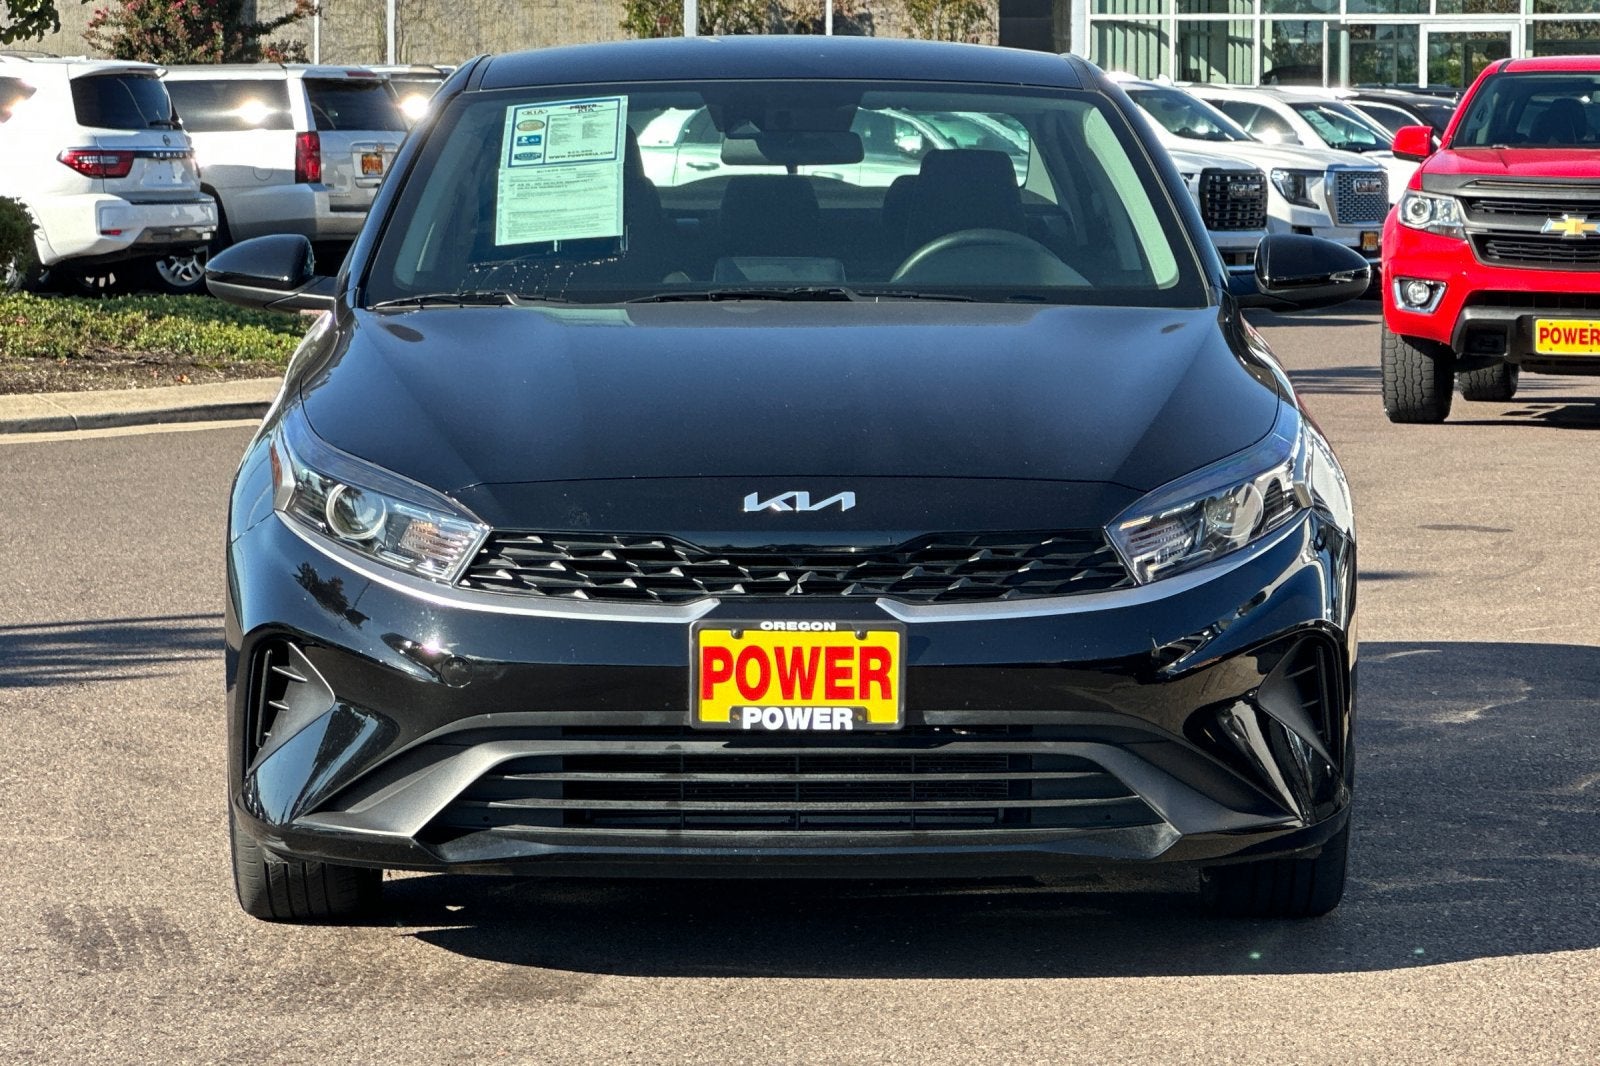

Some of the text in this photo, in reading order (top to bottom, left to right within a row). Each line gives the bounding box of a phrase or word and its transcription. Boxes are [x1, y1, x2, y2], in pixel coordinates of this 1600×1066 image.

[1539, 327, 1600, 346] POWER
[743, 491, 856, 512] KIA
[760, 621, 836, 632] OREGON
[702, 645, 892, 701] POWER
[742, 706, 853, 730] POWER
